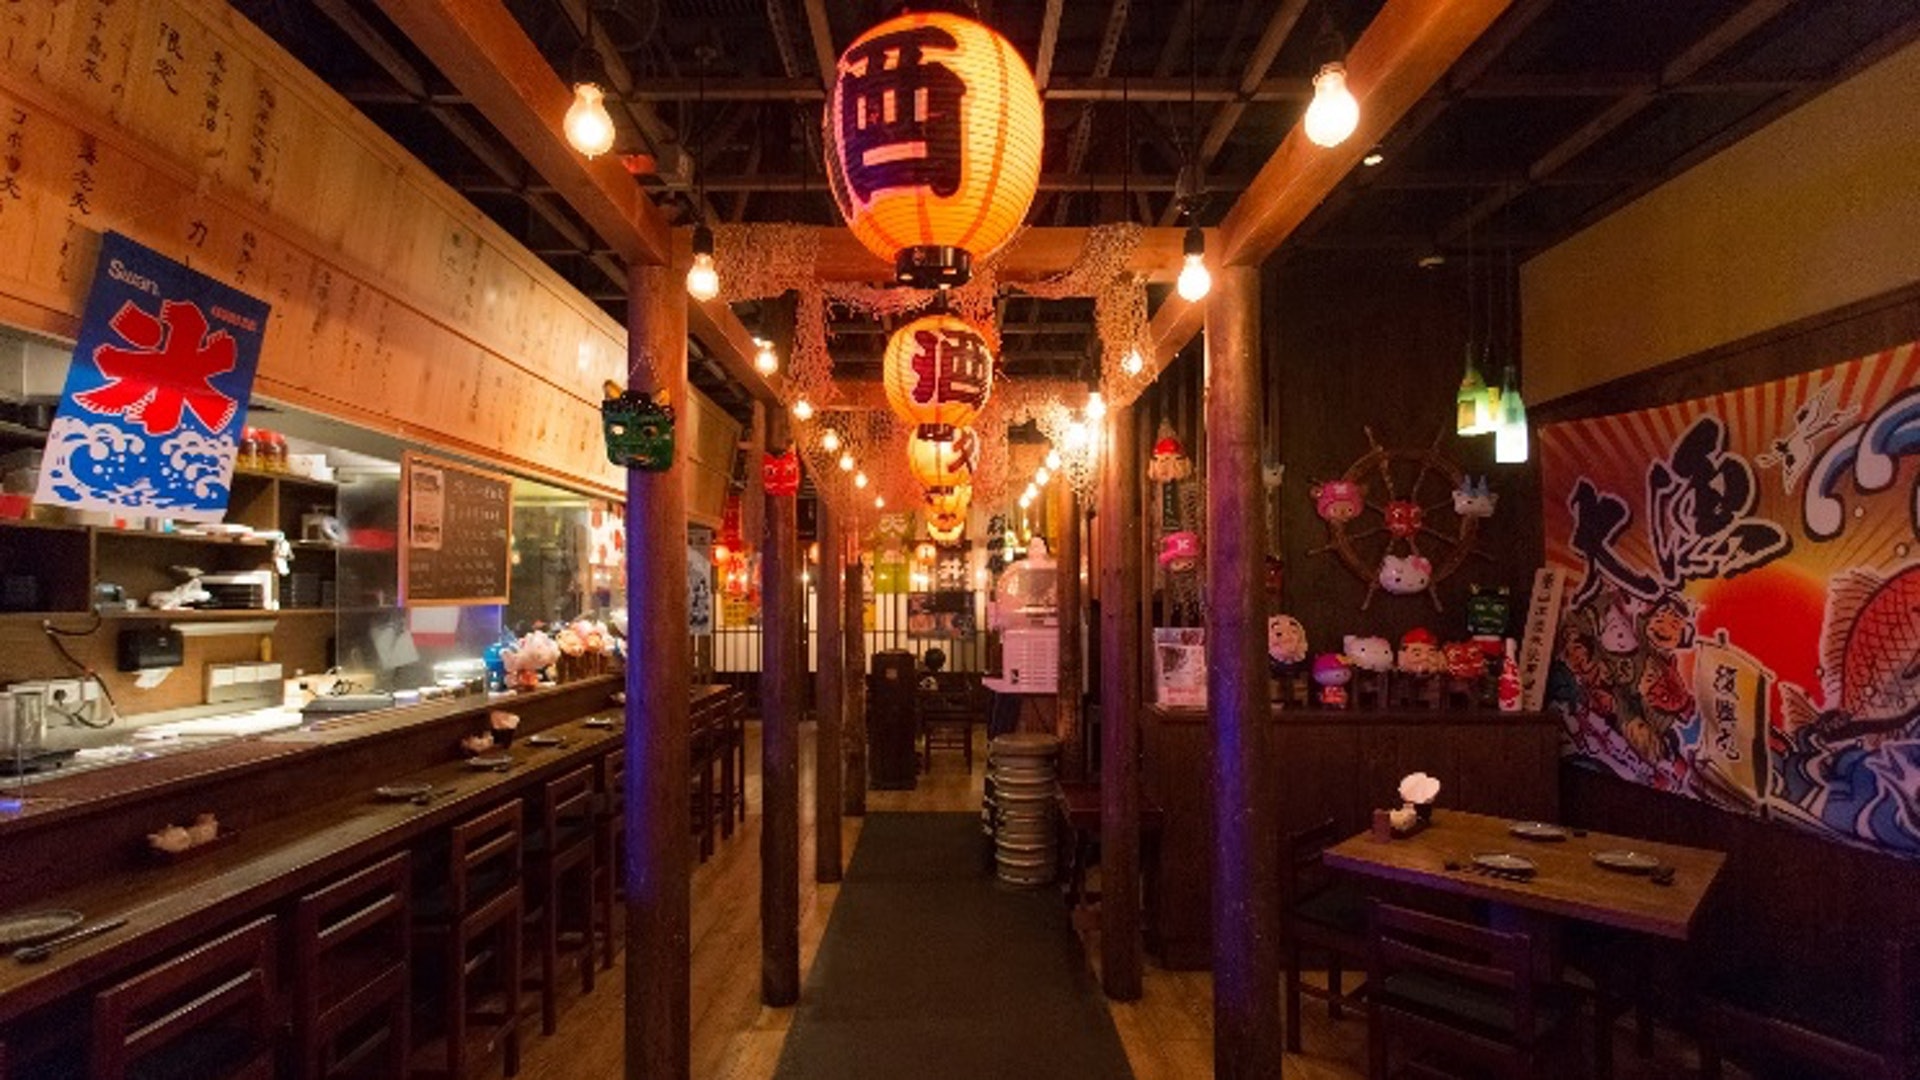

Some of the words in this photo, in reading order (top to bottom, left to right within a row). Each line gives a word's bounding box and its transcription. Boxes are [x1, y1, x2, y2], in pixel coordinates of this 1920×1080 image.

[108, 258, 159, 296] Swan
[71, 299, 239, 436] 氷
[912, 330, 988, 411] 酒
[1567, 414, 1791, 606] 大漁
